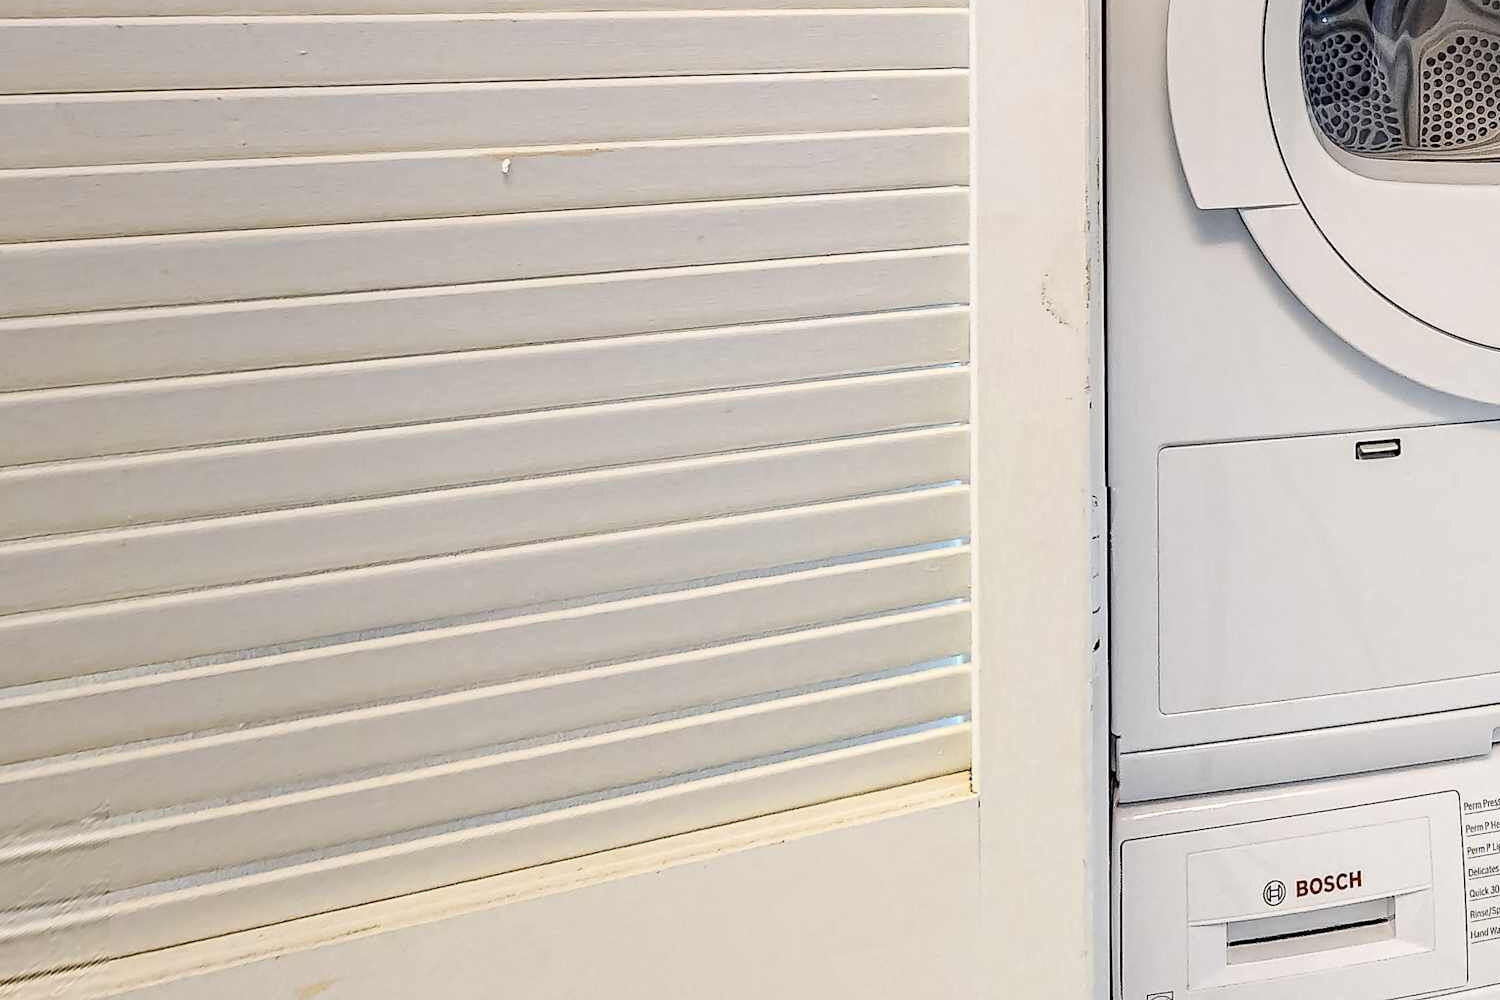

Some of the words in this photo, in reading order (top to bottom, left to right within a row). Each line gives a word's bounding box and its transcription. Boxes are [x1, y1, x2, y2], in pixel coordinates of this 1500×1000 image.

[1464, 801, 1482, 811] Perm
[1483, 798, 1500, 808] Press
[1466, 824, 1483, 833] Perm
[1467, 846, 1484, 855] Perm
[1468, 865, 1499, 877] Delicates
[1296, 870, 1362, 898] BOSCH
[1470, 887, 1489, 898] Quick
[1490, 885, 1500, 894] 30
[1470, 929, 1489, 939] Hand
